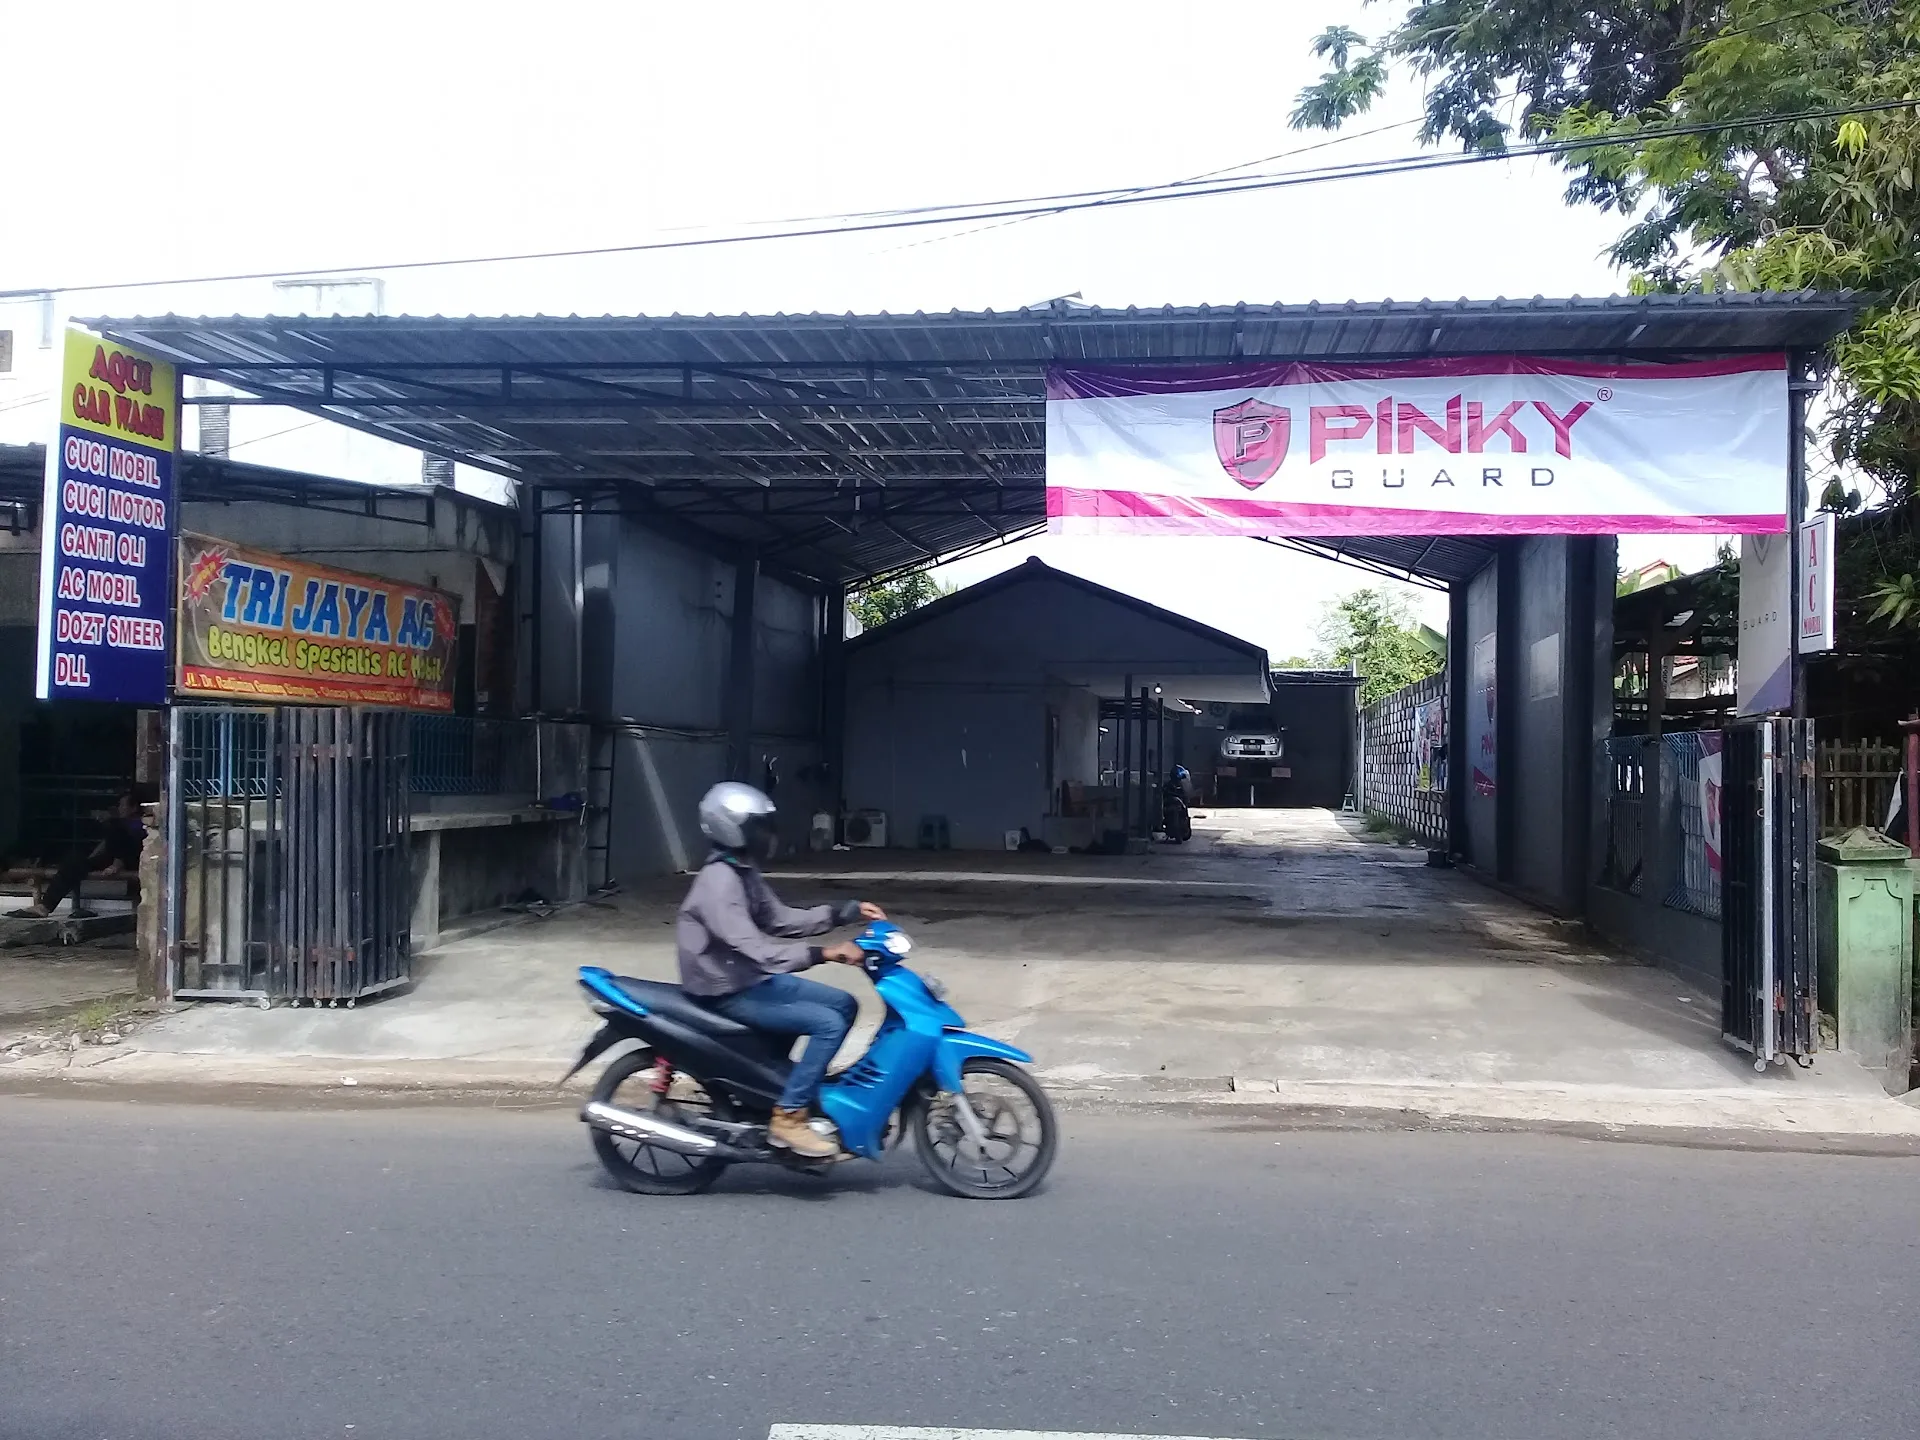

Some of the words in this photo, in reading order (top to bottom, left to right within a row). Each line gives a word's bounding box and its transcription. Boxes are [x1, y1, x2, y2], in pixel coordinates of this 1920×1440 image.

[73, 382, 111, 427] CAR
[114, 394, 164, 441] WASH
[1309, 393, 1596, 465] PINKY
[65, 436, 108, 477] CUCI
[109, 446, 161, 489] MOBIL
[1331, 467, 1555, 489] GUARD
[63, 479, 106, 519] CUCI
[108, 488, 166, 530] MOTOR
[61, 523, 116, 562] GANTI
[117, 533, 146, 567] OLI
[58, 566, 85, 601] AC
[87, 570, 141, 608] MOBIL
[220, 558, 292, 632] TRI
[291, 577, 391, 645] JAYA
[396, 594, 437, 651] AC
[57, 609, 106, 646] DOZT
[107, 615, 164, 650] SMEER
[208, 624, 290, 667] Bengkel
[295, 638, 382, 674] Spesialis
[387, 649, 408, 678] AC
[55, 653, 91, 687] DLL
